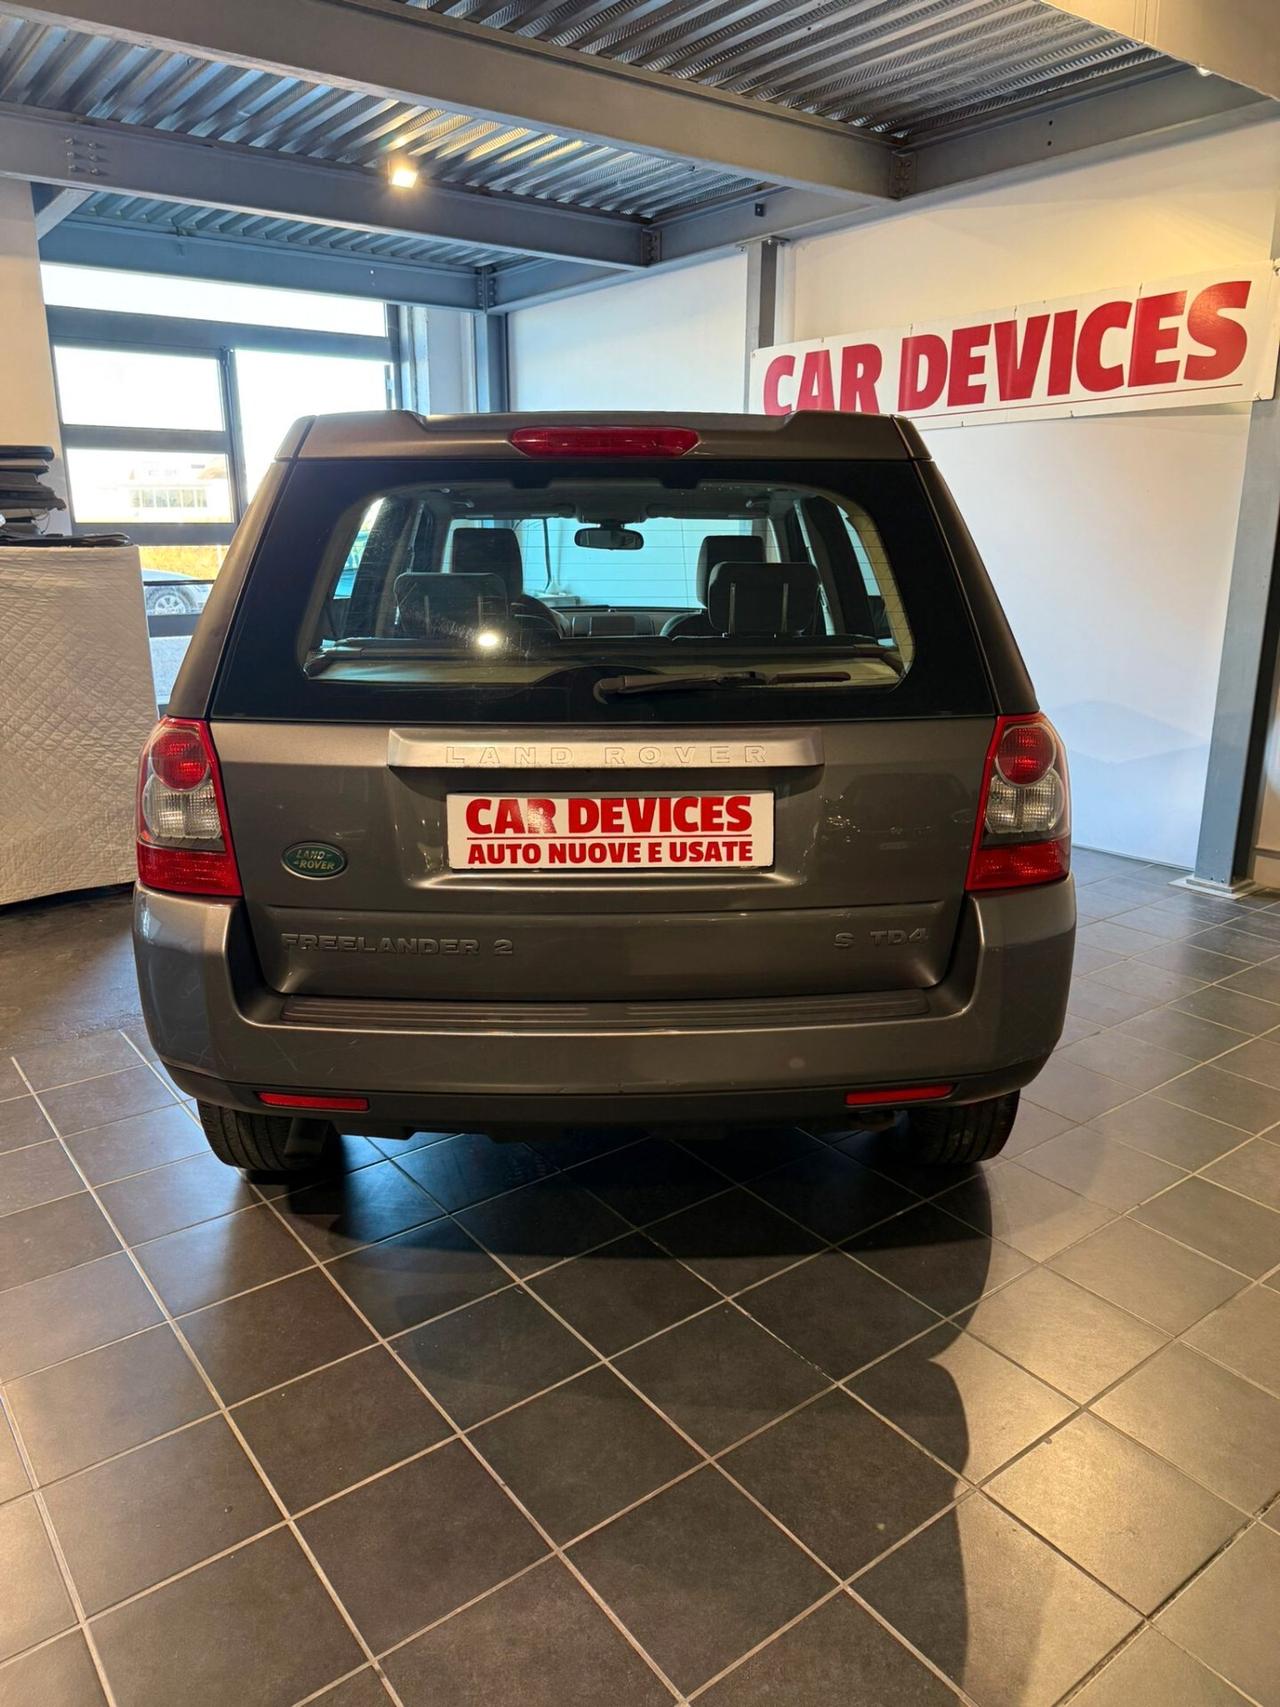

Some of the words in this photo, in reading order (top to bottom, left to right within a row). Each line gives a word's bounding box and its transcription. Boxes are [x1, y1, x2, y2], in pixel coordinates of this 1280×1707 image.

[763, 343, 882, 415] CAR
[898, 280, 1252, 412] DEVICES
[446, 746, 573, 765] LAND
[604, 745, 769, 764] ROVER
[465, 798, 556, 835] CAR
[567, 796, 753, 833] DEVICES
[467, 842, 542, 864] AUTO
[549, 842, 642, 863] NUOVE
[648, 842, 662, 862] E
[669, 841, 753, 862] USATE
[281, 933, 480, 956] FREELANDER
[493, 939, 513, 955] 2
[834, 932, 854, 947] S
[870, 928, 928, 945] TD4
